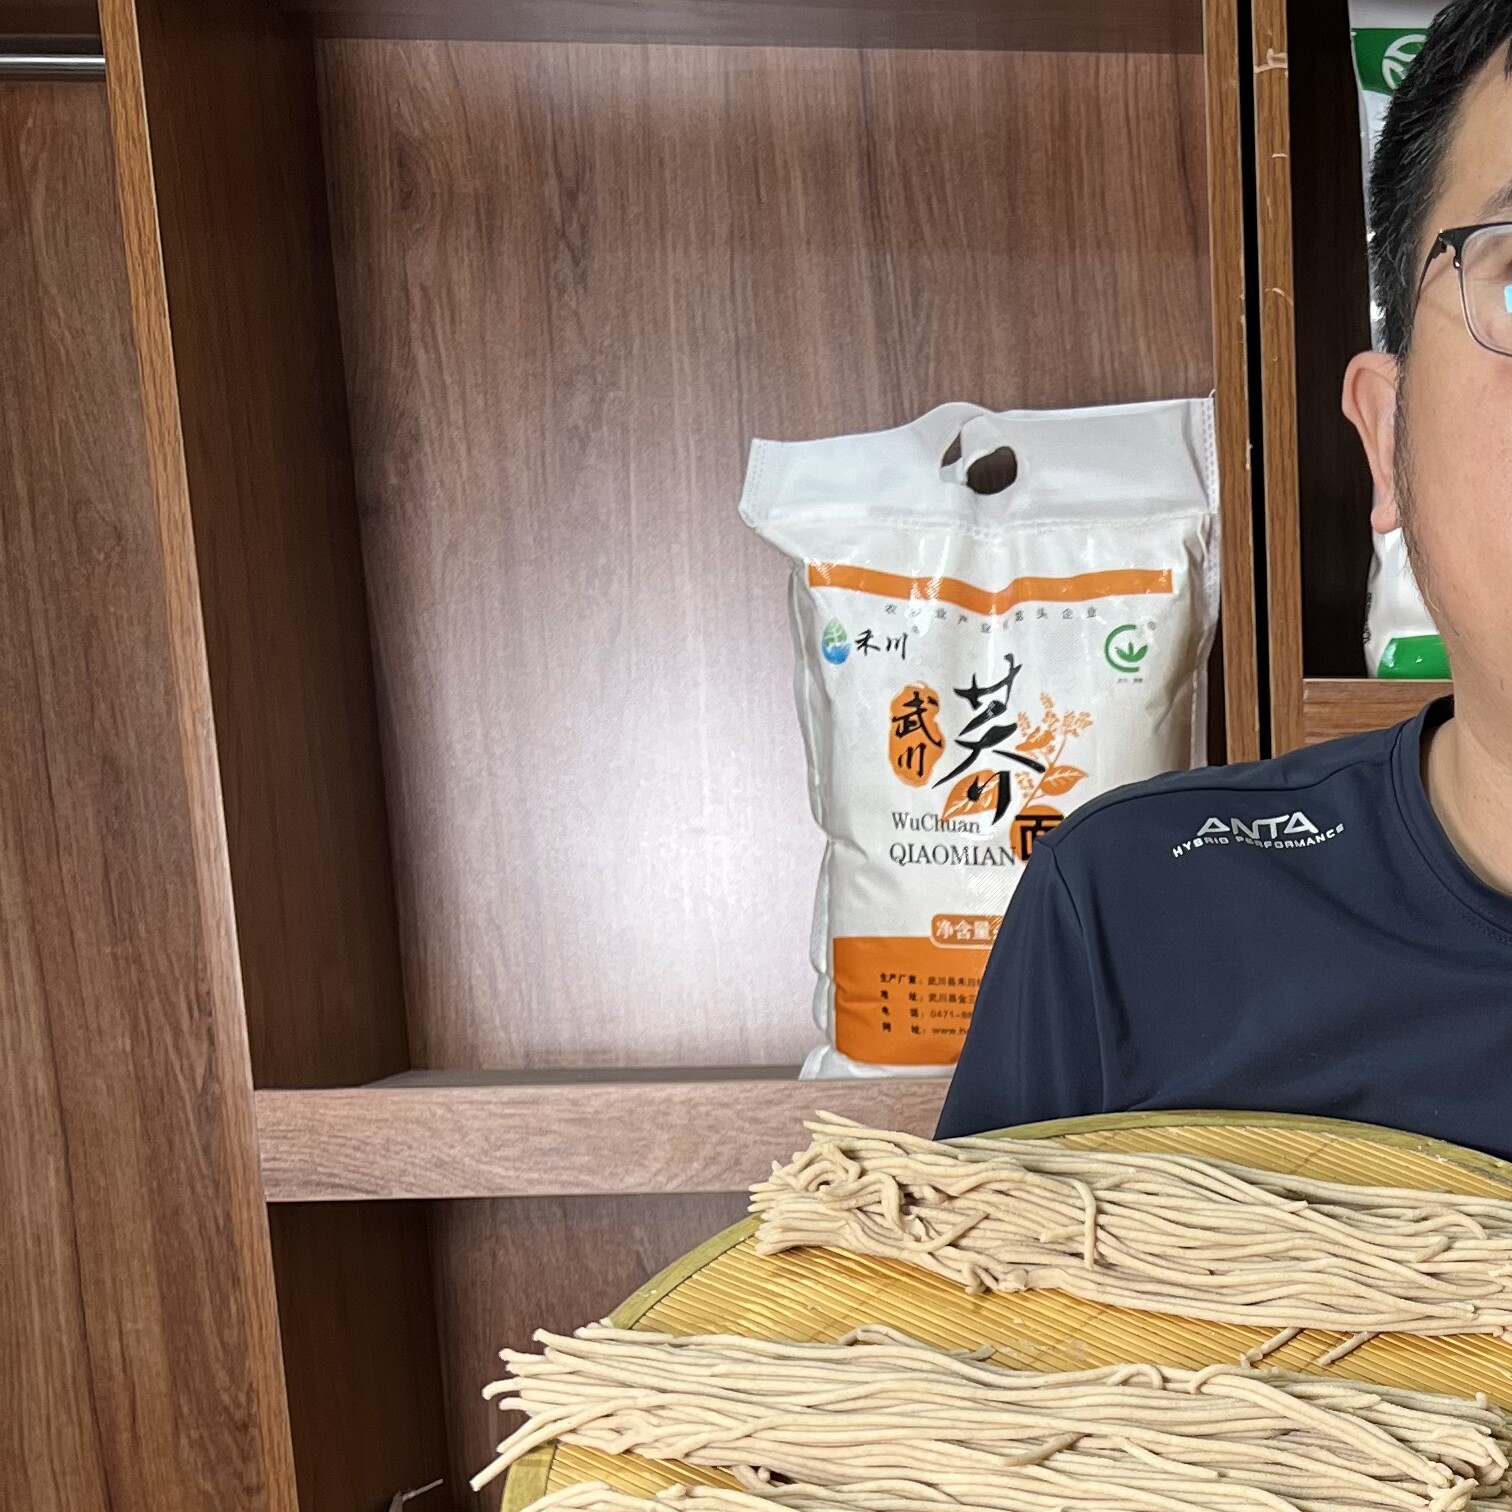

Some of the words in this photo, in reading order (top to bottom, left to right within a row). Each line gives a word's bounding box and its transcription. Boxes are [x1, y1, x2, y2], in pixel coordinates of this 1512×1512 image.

[855, 627, 908, 660] 禾川
[891, 690, 943, 778] 武川
[891, 810, 981, 834] WuChuan
[1196, 811, 1319, 840] ANTA
[889, 841, 1017, 867] QIAOMIAN
[1172, 835, 1230, 858] HYBRID
[1234, 823, 1345, 849] PERFORMANCE
